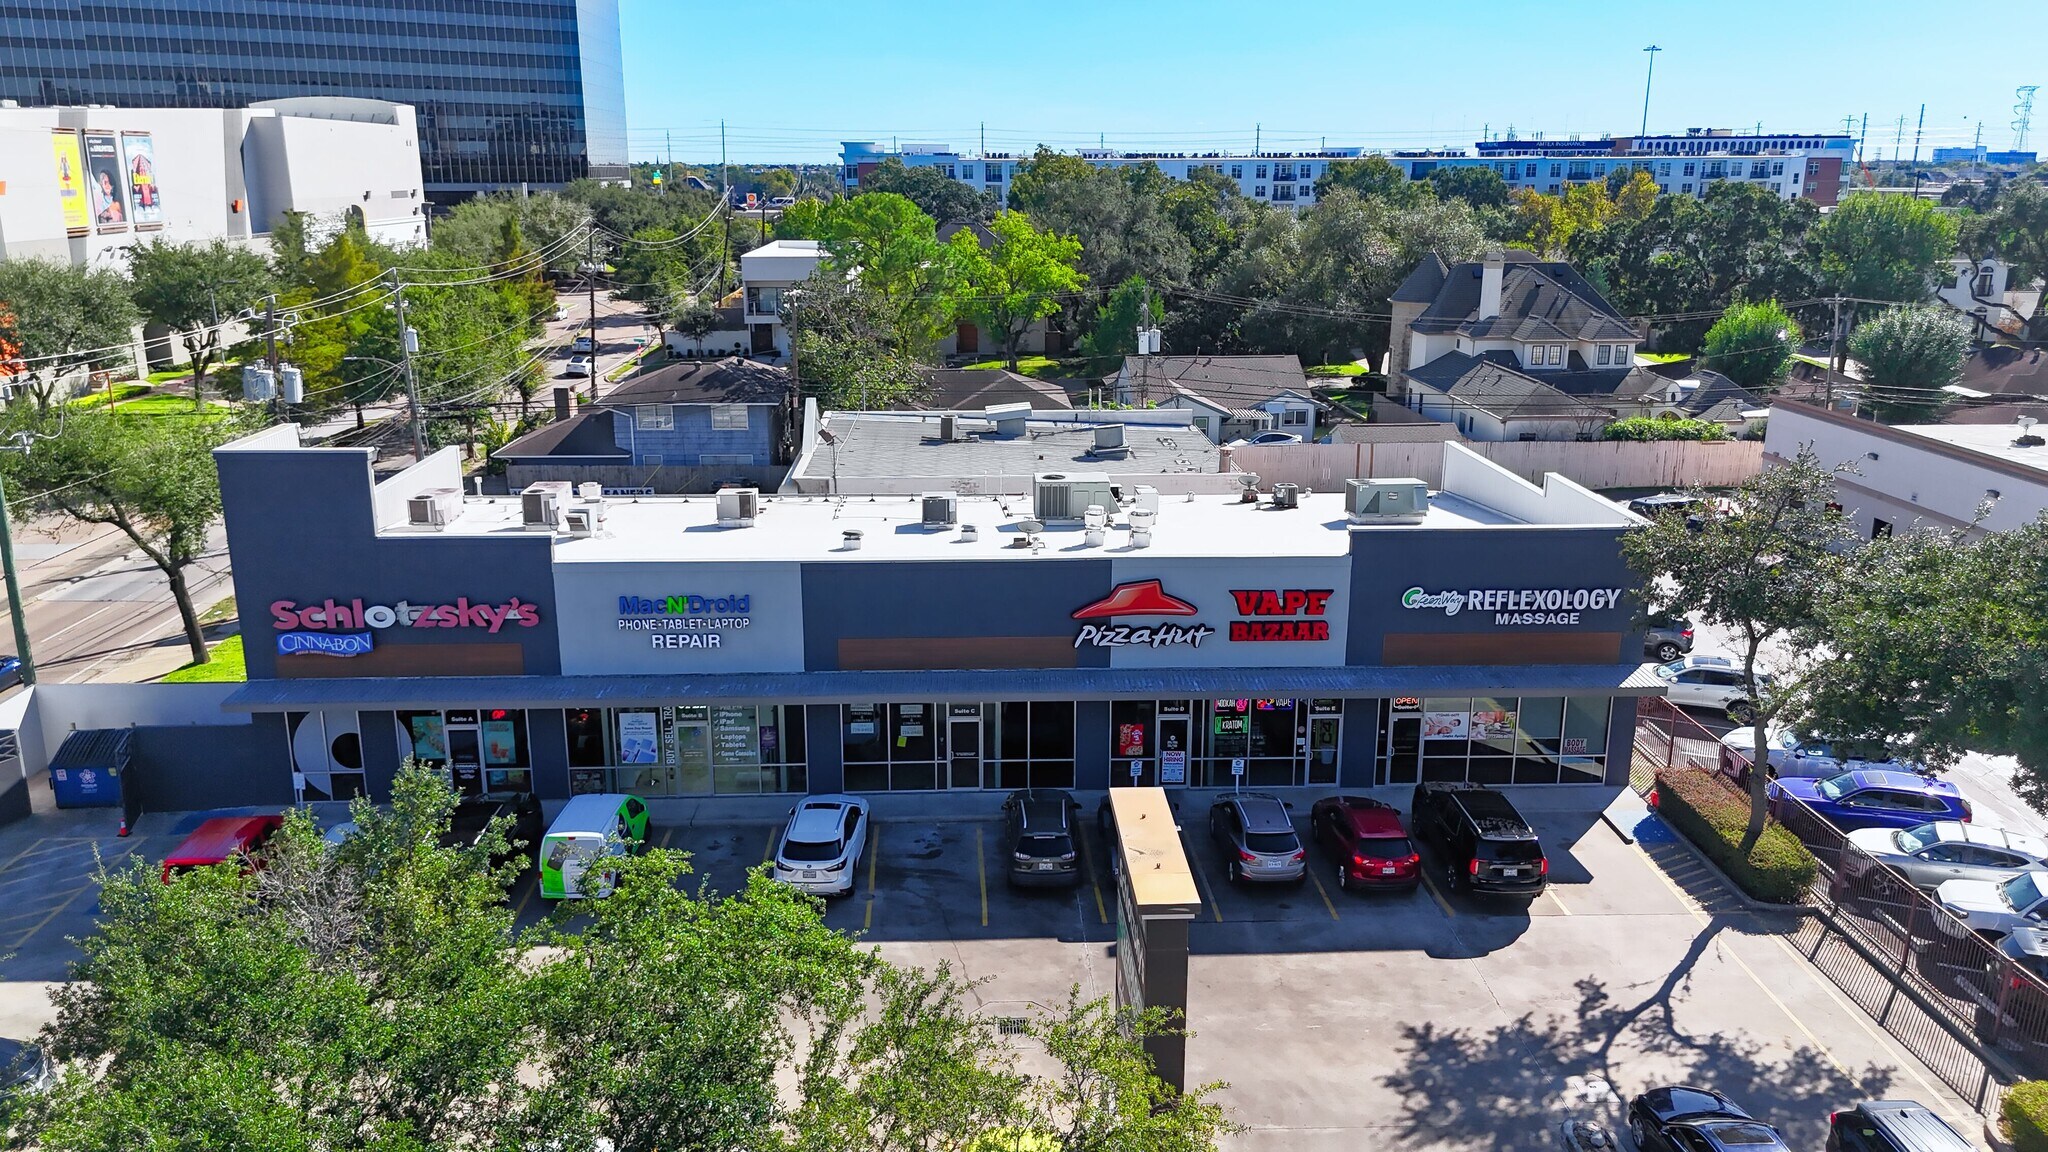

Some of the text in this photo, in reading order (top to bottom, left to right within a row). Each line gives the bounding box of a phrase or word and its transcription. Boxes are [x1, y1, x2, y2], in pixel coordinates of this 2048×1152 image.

[619, 594, 750, 615] MacN'Droid
[1229, 589, 1334, 616] VAPE
[1467, 589, 1621, 611] REFLEXOLOGY
[270, 597, 539, 633] Schlotzsky's
[1495, 612, 1580, 625] MASSAGE
[618, 618, 750, 631] PHONE TABLET LAPTOP
[1229, 620, 1329, 641] BAZAAR
[652, 634, 721, 649] REPAIR
[1074, 622, 1215, 648] Pizza Hut
[280, 634, 371, 652] CINNABON
[1218, 699, 1236, 708] HOOKAH
[1275, 698, 1291, 707] VAPE
[1395, 697, 1418, 705] OPEN
[1221, 719, 1243, 730] KRATOM
[664, 725, 674, 744] SELL
[720, 733, 747, 741] Laptops
[1564, 746, 1586, 754] MASSAGE
[1566, 739, 1585, 747] BODY
[666, 748, 676, 764] BUY
